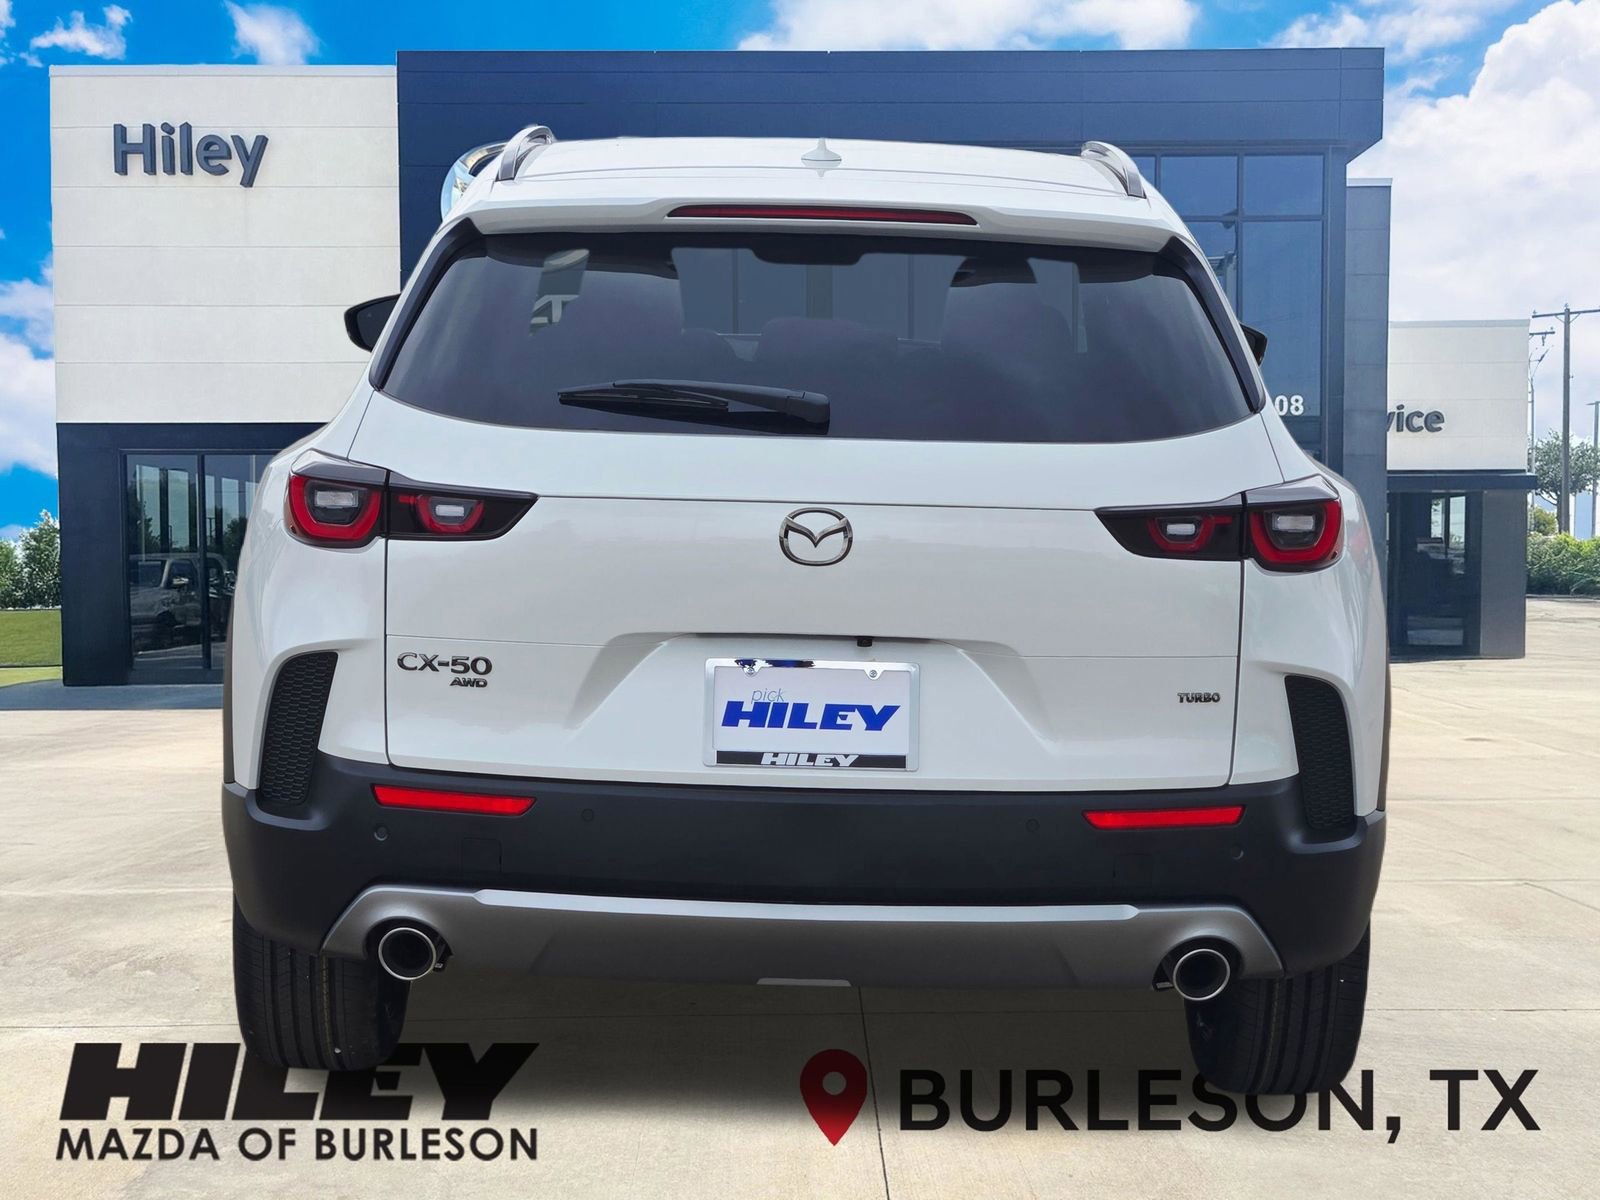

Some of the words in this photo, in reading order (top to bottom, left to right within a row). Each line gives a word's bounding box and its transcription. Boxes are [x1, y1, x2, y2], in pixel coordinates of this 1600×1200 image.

[113, 121, 269, 188] Hiley
[397, 652, 493, 676] CX-50
[449, 677, 488, 688] AWD
[750, 688, 785, 704] pick
[1177, 692, 1221, 703] TURBO
[721, 700, 901, 731] HILEY
[760, 752, 859, 767] HILEY
